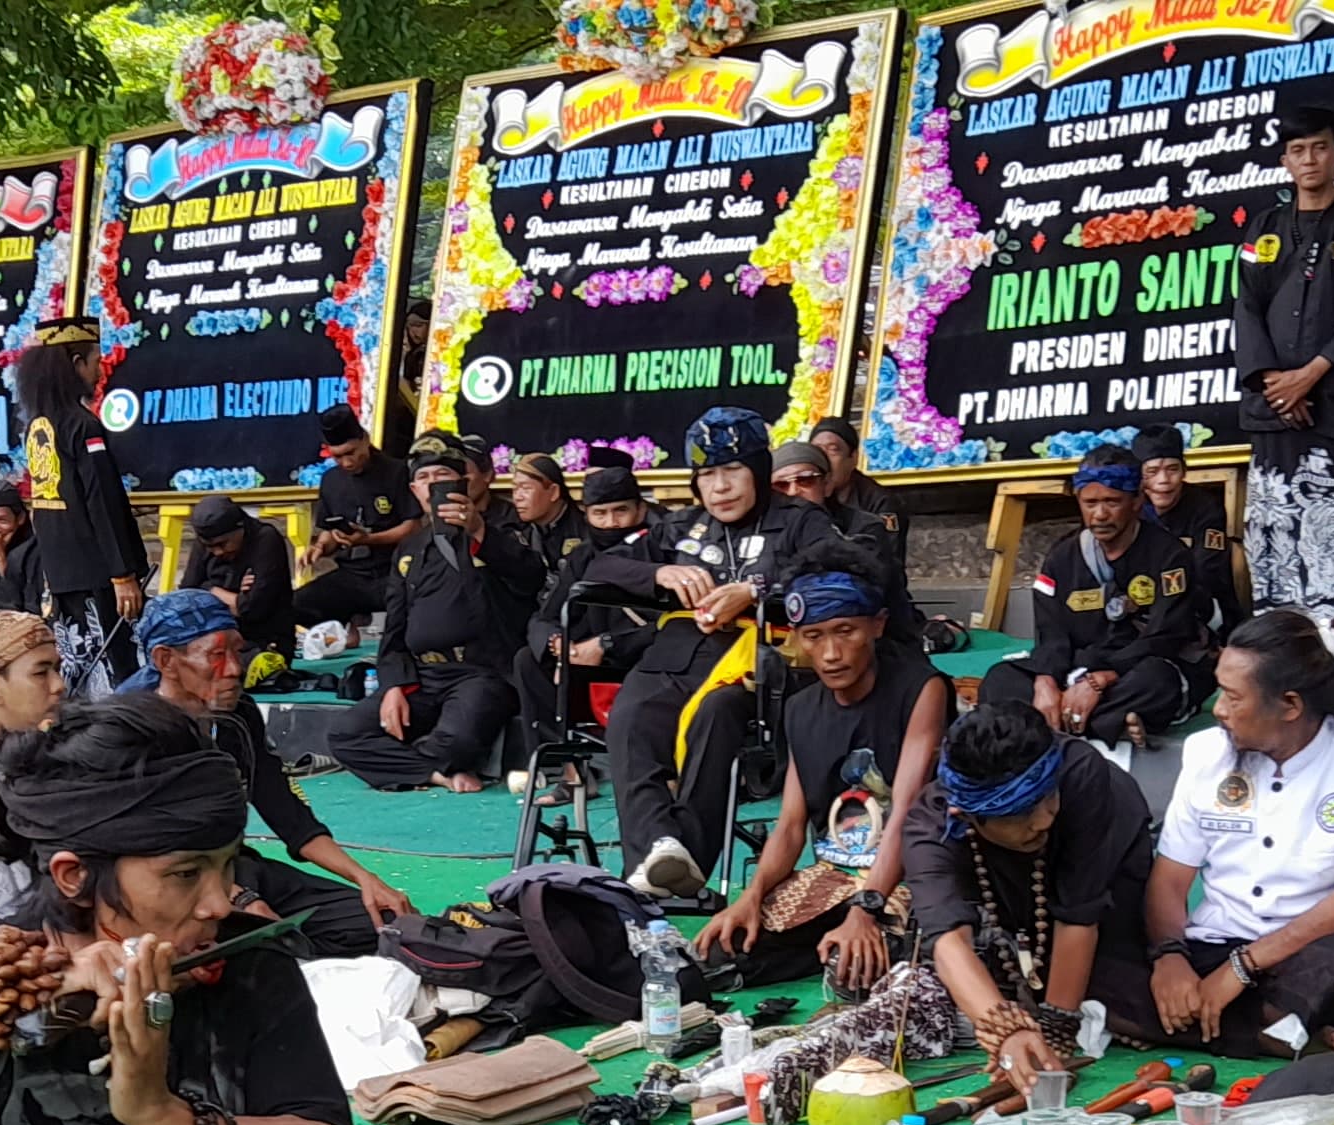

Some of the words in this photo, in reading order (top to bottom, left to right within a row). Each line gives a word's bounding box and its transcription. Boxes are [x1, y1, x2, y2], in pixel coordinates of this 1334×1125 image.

[1052, 9, 1135, 68] Happy
[562, 88, 625, 142] Happy
[965, 94, 1037, 137] LASKAR
[1044, 80, 1112, 123] AGUNG
[1118, 66, 1191, 110] MACAN
[1197, 56, 1236, 94] ALI
[1048, 109, 1169, 149] KESULTANAN
[1185, 91, 1276, 126] CIREBON
[496, 154, 553, 188] LASKAR
[556, 147, 609, 182] AGUNG
[613, 139, 672, 175] MACAN
[673, 134, 705, 168] ALI
[708, 121, 814, 164] NUSWANTARA
[1000, 154, 1124, 189] Dasawarsa
[1133, 123, 1251, 171] Mengabdi
[129, 203, 170, 234] LASKAR
[171, 197, 211, 228] AGUNG
[255, 187, 277, 216] ALI
[560, 177, 654, 205] KESULTANAN
[664, 168, 731, 194] CIREBON
[623, 199, 713, 234] Mengabdi
[718, 195, 764, 219] Setia
[995, 195, 1061, 231] Njaga
[1072, 177, 1169, 214] Marwah
[1182, 161, 1294, 198] Kesultan
[249, 217, 297, 240] CIREBON
[655, 233, 759, 260] Kesultanan
[987, 259, 1121, 331] IRIANTO
[1136, 244, 1243, 313] SANT
[518, 354, 617, 398] PT.DHARMA
[623, 346, 722, 392] PRECISION
[730, 344, 787, 387] TOOL
[1009, 331, 1127, 376] PRESIDEN
[1143, 318, 1236, 362] DIREKT
[223, 378, 312, 418] ELECTRINDO
[958, 382, 1089, 426] PT.DHARMA
[1107, 367, 1242, 412] POLIMETAL
